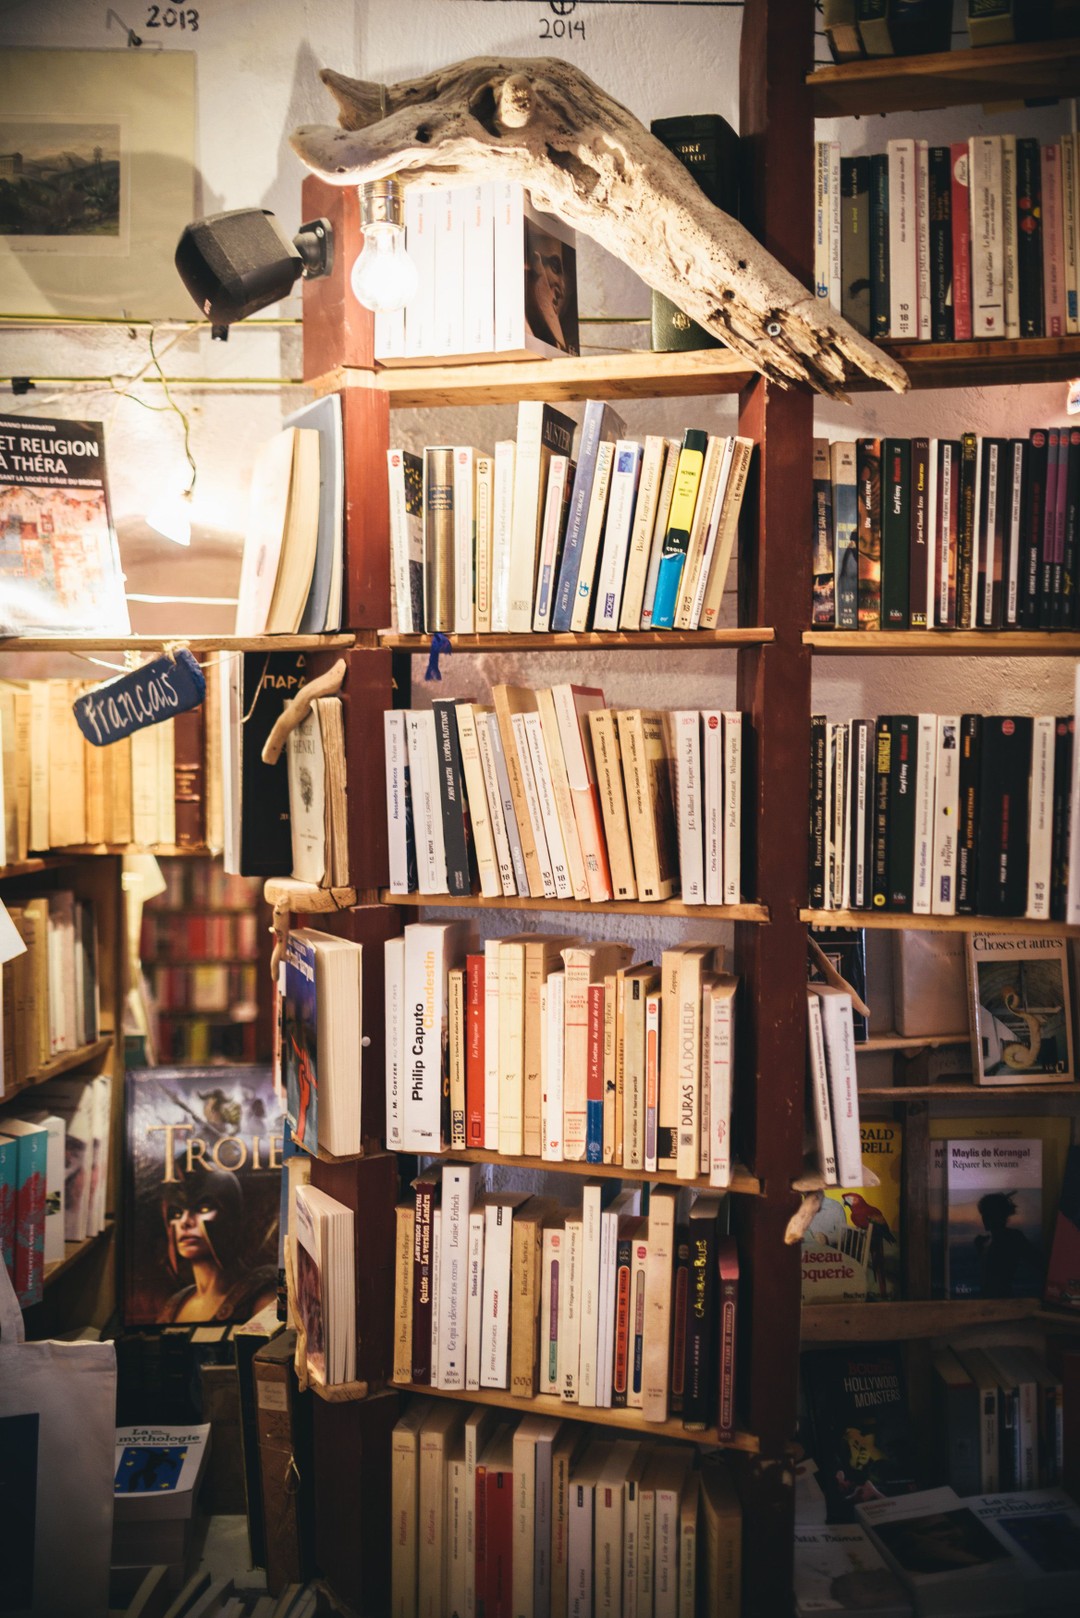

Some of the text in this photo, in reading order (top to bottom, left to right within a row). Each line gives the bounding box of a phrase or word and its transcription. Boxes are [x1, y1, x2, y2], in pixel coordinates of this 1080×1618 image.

[146, 8, 199, 31] 2013
[538, 18, 586, 41] 2014
[832, 197, 840, 225] prochaine
[832, 262, 840, 279] James
[900, 303, 909, 311] 10
[20, 437, 99, 458] RELIGION
[11, 454, 69, 475] THÉRA
[572, 525, 580, 540] NUIT
[635, 528, 645, 552] Balzac
[440, 710, 450, 739] FLOTTANT
[685, 738, 693, 755] Soleil
[446, 767, 454, 786] BARTH
[686, 766, 694, 788] Empire
[447, 786, 455, 801] JOHN
[688, 818, 696, 831] J.G.
[815, 835, 823, 866] Raymond
[941, 876, 950, 902] POCKET
[973, 937, 1064, 951] Choses et autres
[422, 951, 435, 1029] Clandestin
[670, 970, 678, 995] Zapping
[604, 1002, 614, 1056] Conrad Typhon
[411, 1003, 426, 1101] Philip Caputo
[680, 1002, 695, 1126] DURAS LA DOULEUR
[453, 1111, 464, 1134] 10 18
[147, 1123, 284, 1183] TROIE
[826, 1156, 834, 1164] 10
[952, 1148, 1030, 1160] Maylis de Kerangal
[827, 1166, 836, 1174] 18
[952, 1159, 1019, 1171] Réparer les vivants
[422, 1194, 430, 1223] Landru
[450, 1194, 460, 1221] Erdrich
[421, 1224, 429, 1252] version
[450, 1223, 459, 1248] Louise
[420, 1254, 429, 1264] La
[694, 1239, 707, 1267] BLUES
[420, 1276, 430, 1303] Quinte
[449, 1283, 457, 1295] nos
[521, 1269, 529, 1296] Faulkner
[447, 1296, 458, 1320] dévoré
[447, 1327, 458, 1339] qui
[447, 1341, 456, 1351] Ce
[844, 1375, 898, 1392] HOLLYWOOD
[855, 1389, 901, 1408] MONSTERS
[118, 1434, 200, 1443] mythologie
[399, 1510, 408, 1546] Plateforme
[427, 1509, 436, 1545] Plateforme
